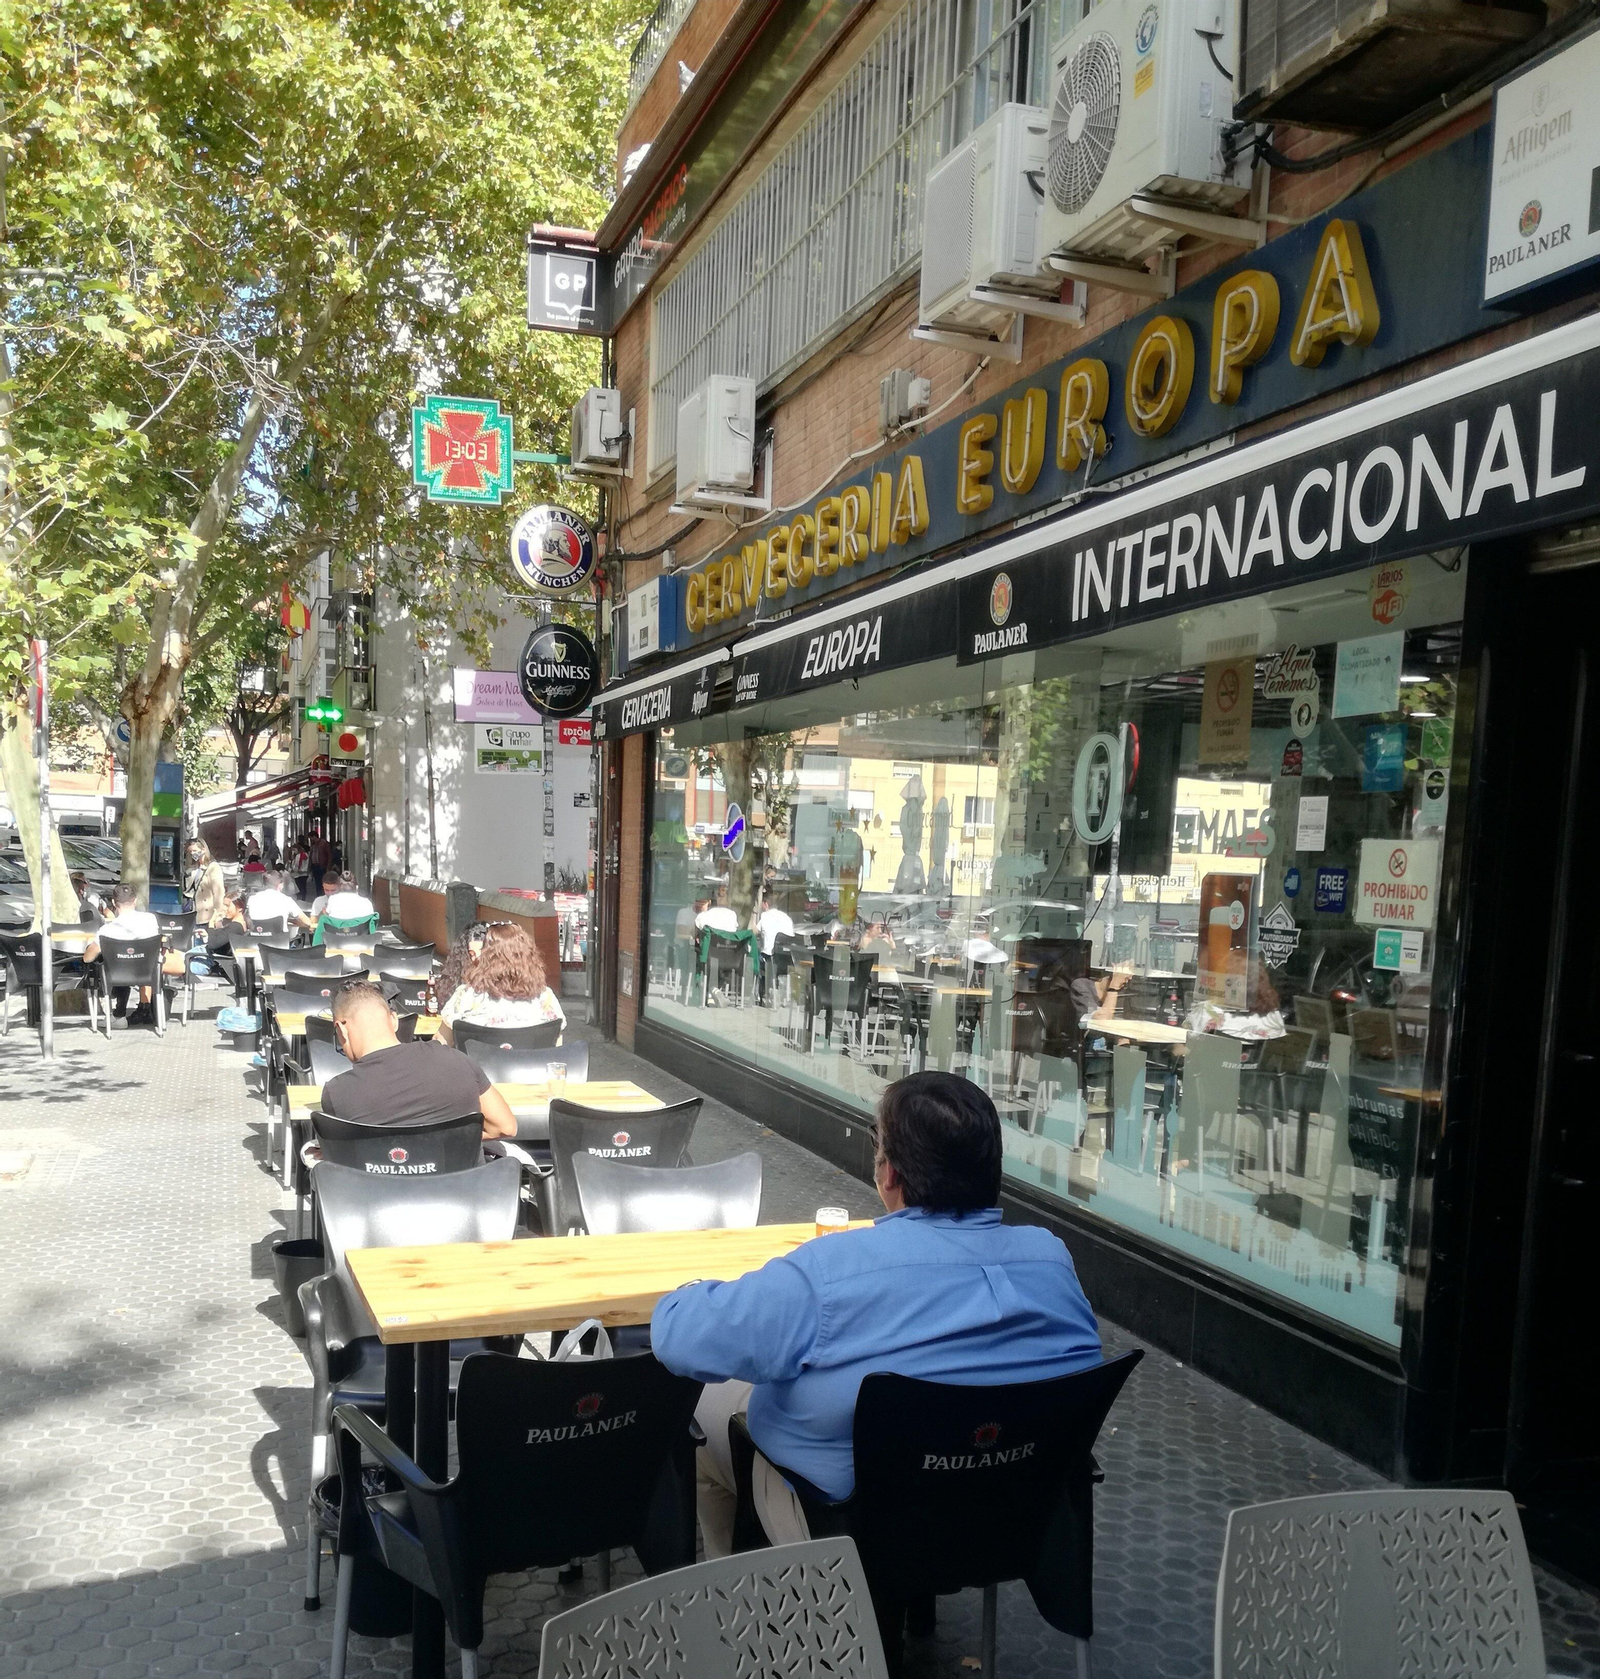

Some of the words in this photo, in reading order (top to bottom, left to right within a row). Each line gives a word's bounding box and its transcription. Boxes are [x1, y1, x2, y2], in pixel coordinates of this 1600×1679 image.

[1502, 108, 1573, 166] Affligem
[614, 227, 644, 289] GRUPO
[1488, 223, 1572, 276] PAULANER
[957, 218, 1380, 515] EUROPA
[445, 440, 488, 460] 13:03
[1072, 389, 1587, 622] INTERNACIONAL
[519, 510, 590, 546] PAULANER
[685, 455, 929, 633] CERVECERIA
[1377, 568, 1403, 588] LARIOS
[801, 615, 883, 679] EUROPA
[973, 622, 1029, 655] PAULANER
[525, 661, 590, 680] GUINNESS
[505, 681, 523, 695] Na
[621, 685, 672, 730] CERVECERIA
[505, 729, 531, 740] Grupo
[1197, 807, 1276, 857] MAES
[1319, 874, 1345, 890] FREE
[1364, 882, 1428, 902] PROHIBIDO
[1373, 902, 1415, 921] FUMAR
[1349, 1092, 1404, 1119] mbrumas
[588, 1146, 652, 1158] PAULANER
[365, 1162, 437, 1175] PAULANER
[525, 1410, 637, 1444] PAULANER
[922, 1442, 1035, 1470] PAULANER
